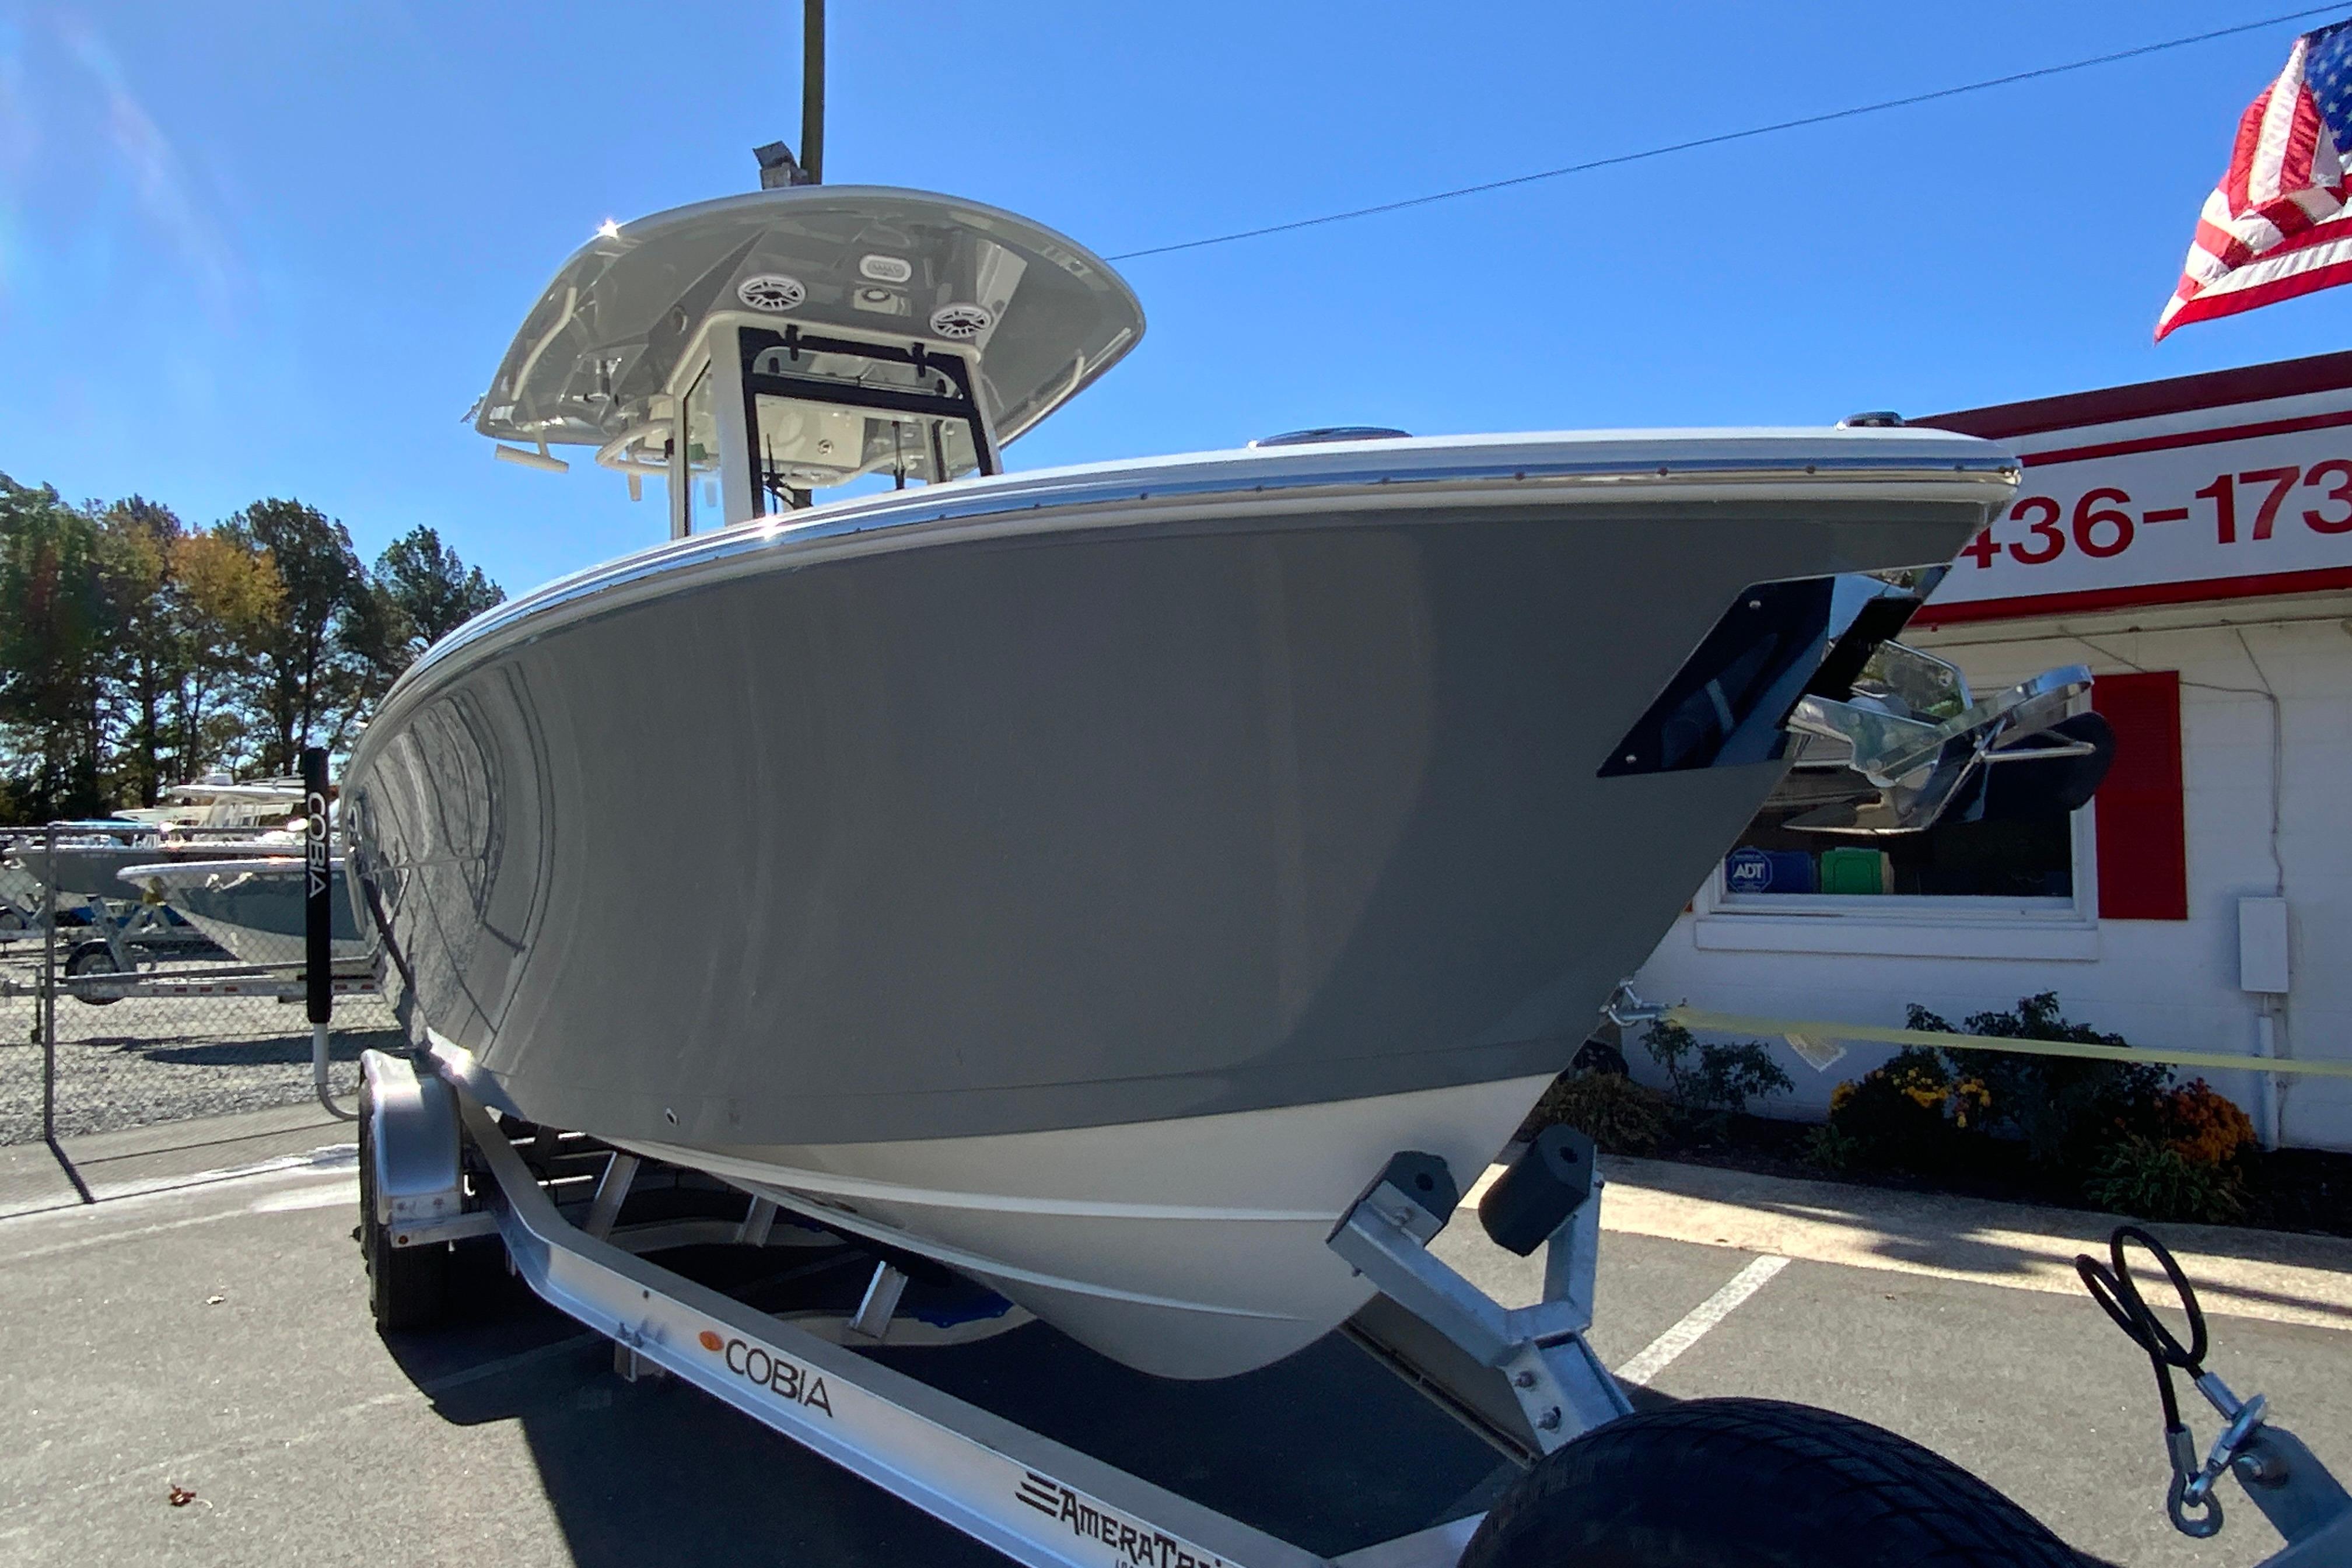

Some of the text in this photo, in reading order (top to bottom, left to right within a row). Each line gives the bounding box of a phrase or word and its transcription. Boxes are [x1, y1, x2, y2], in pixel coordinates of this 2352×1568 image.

[308, 792, 327, 898] COBIA
[1733, 863, 1765, 878] ADT
[726, 1338, 833, 1418] COBIA
